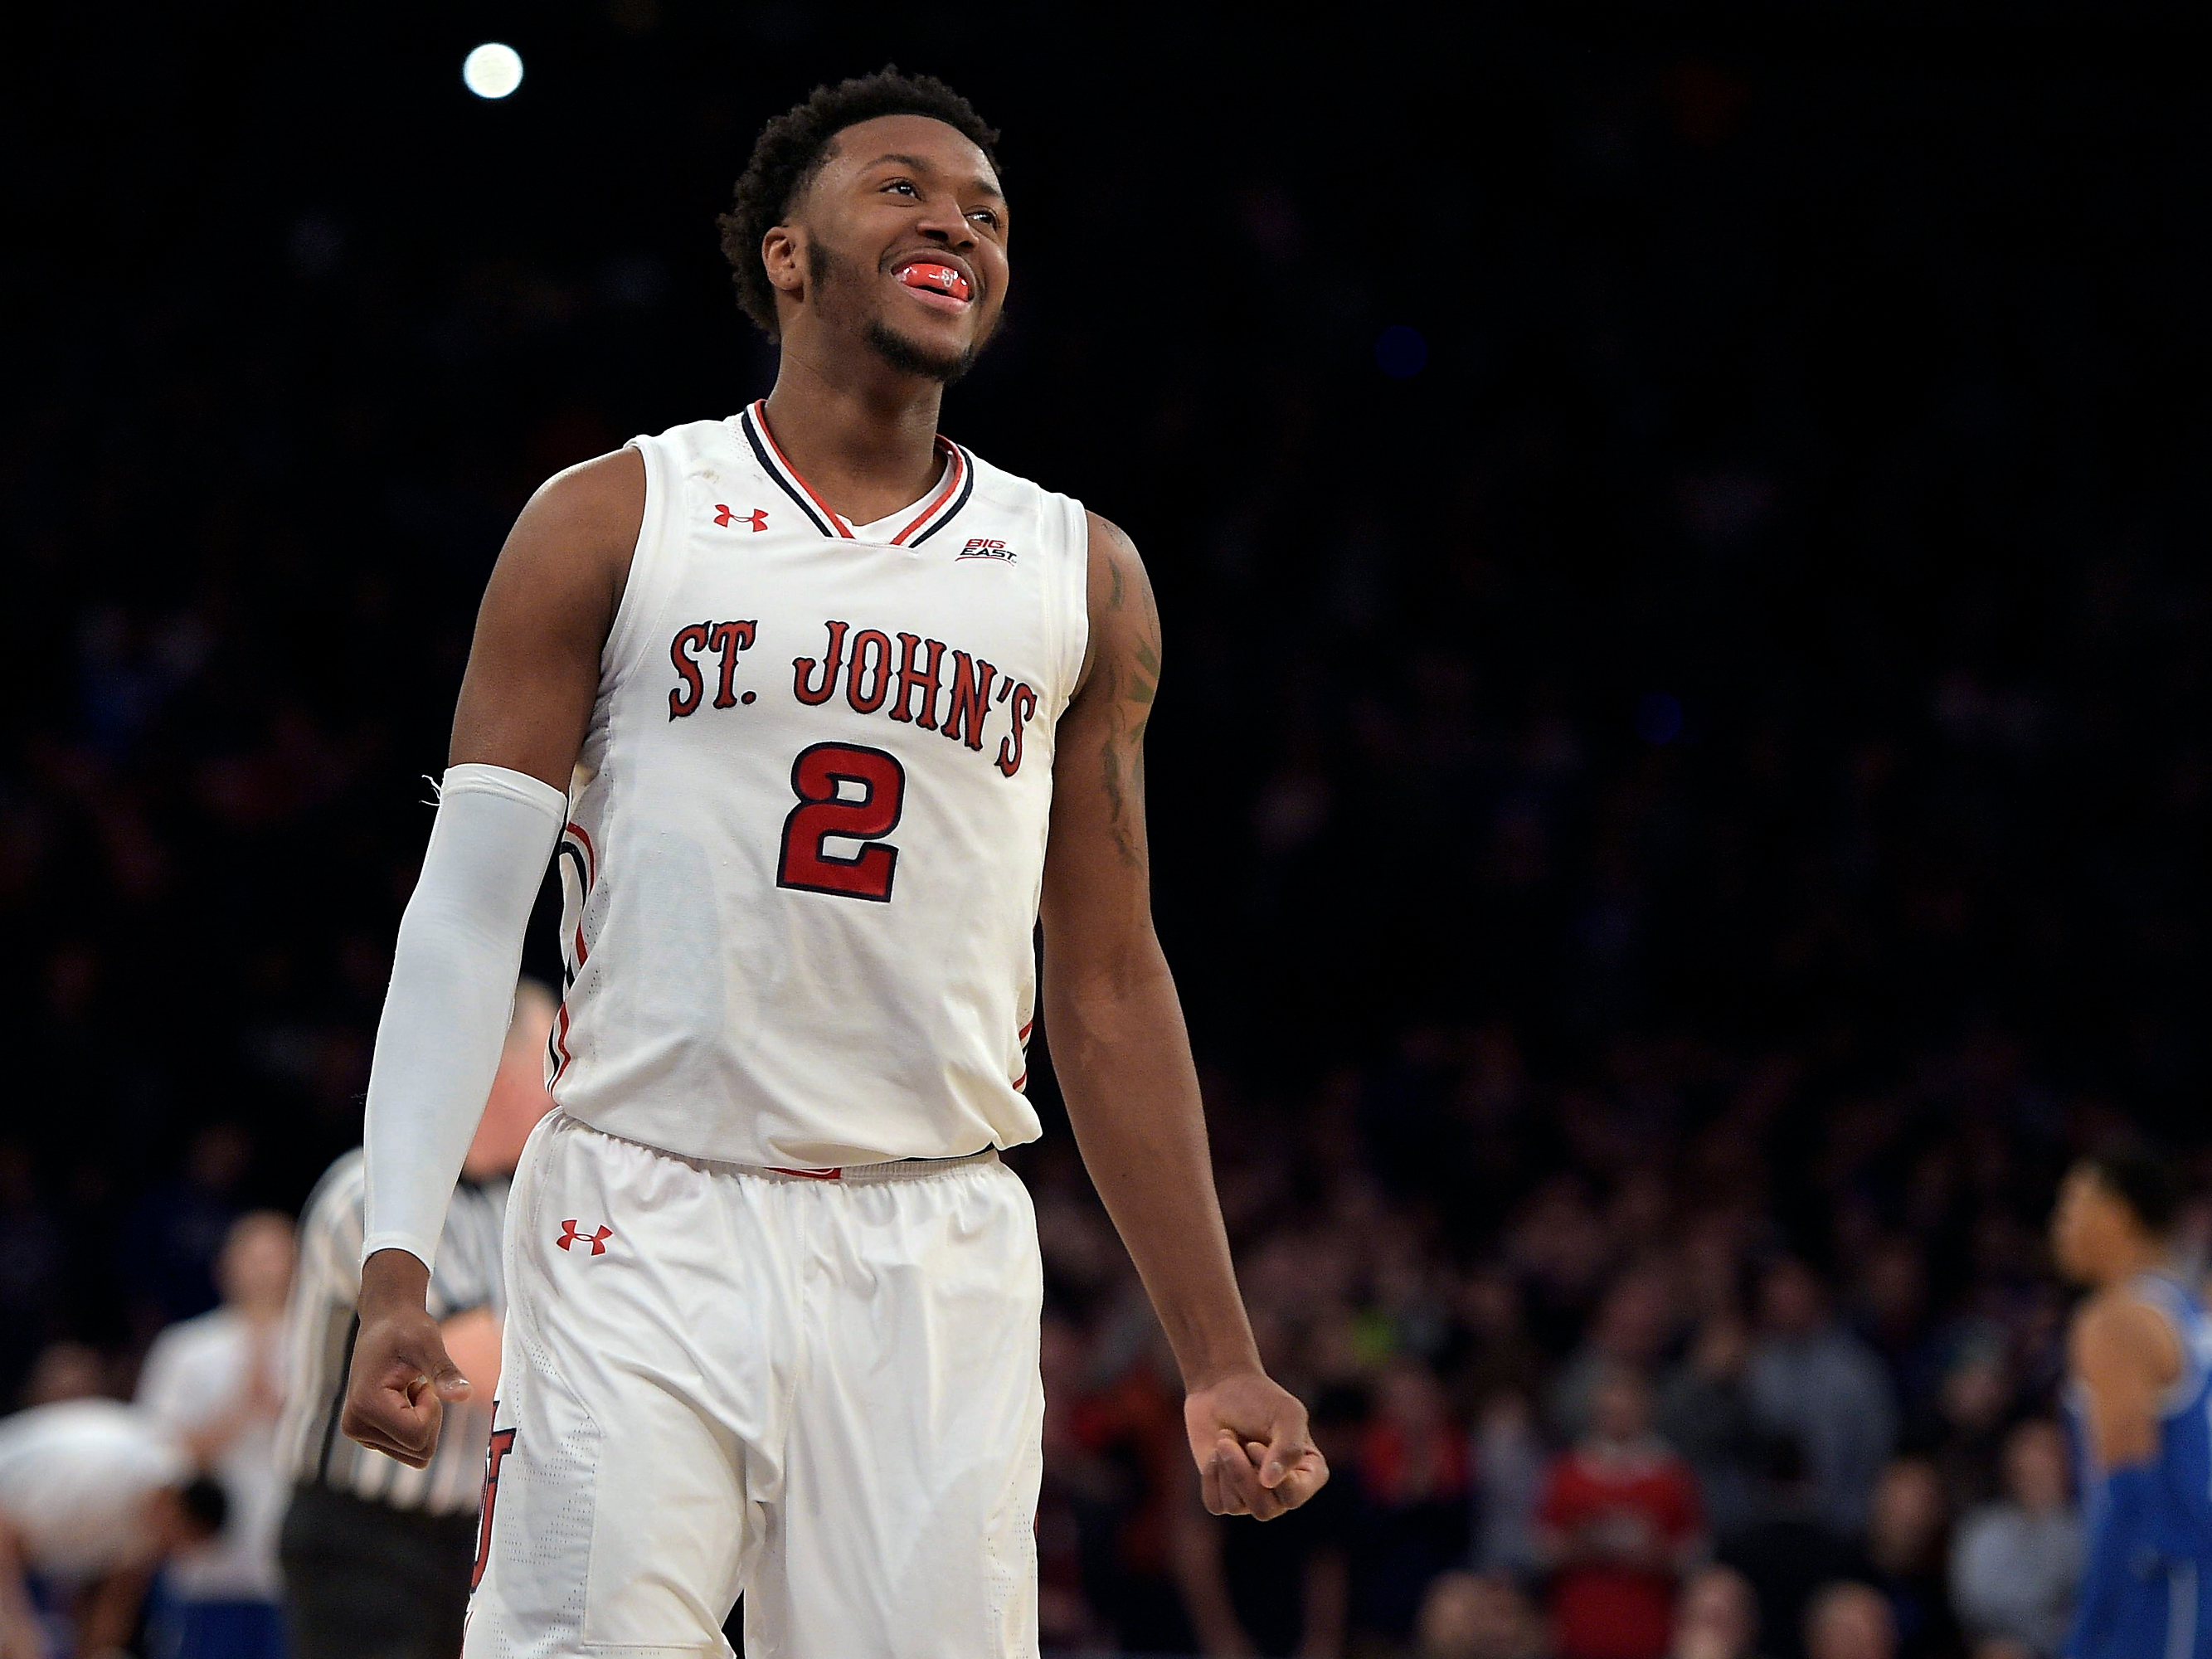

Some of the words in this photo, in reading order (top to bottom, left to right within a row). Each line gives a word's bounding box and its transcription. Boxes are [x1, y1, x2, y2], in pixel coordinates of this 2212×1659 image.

[960, 547, 1017, 560] EAST
[965, 538, 1007, 548] BIG
[668, 620, 757, 722] ST.
[792, 620, 1038, 777] JOHN'S
[776, 742, 906, 902] 2
